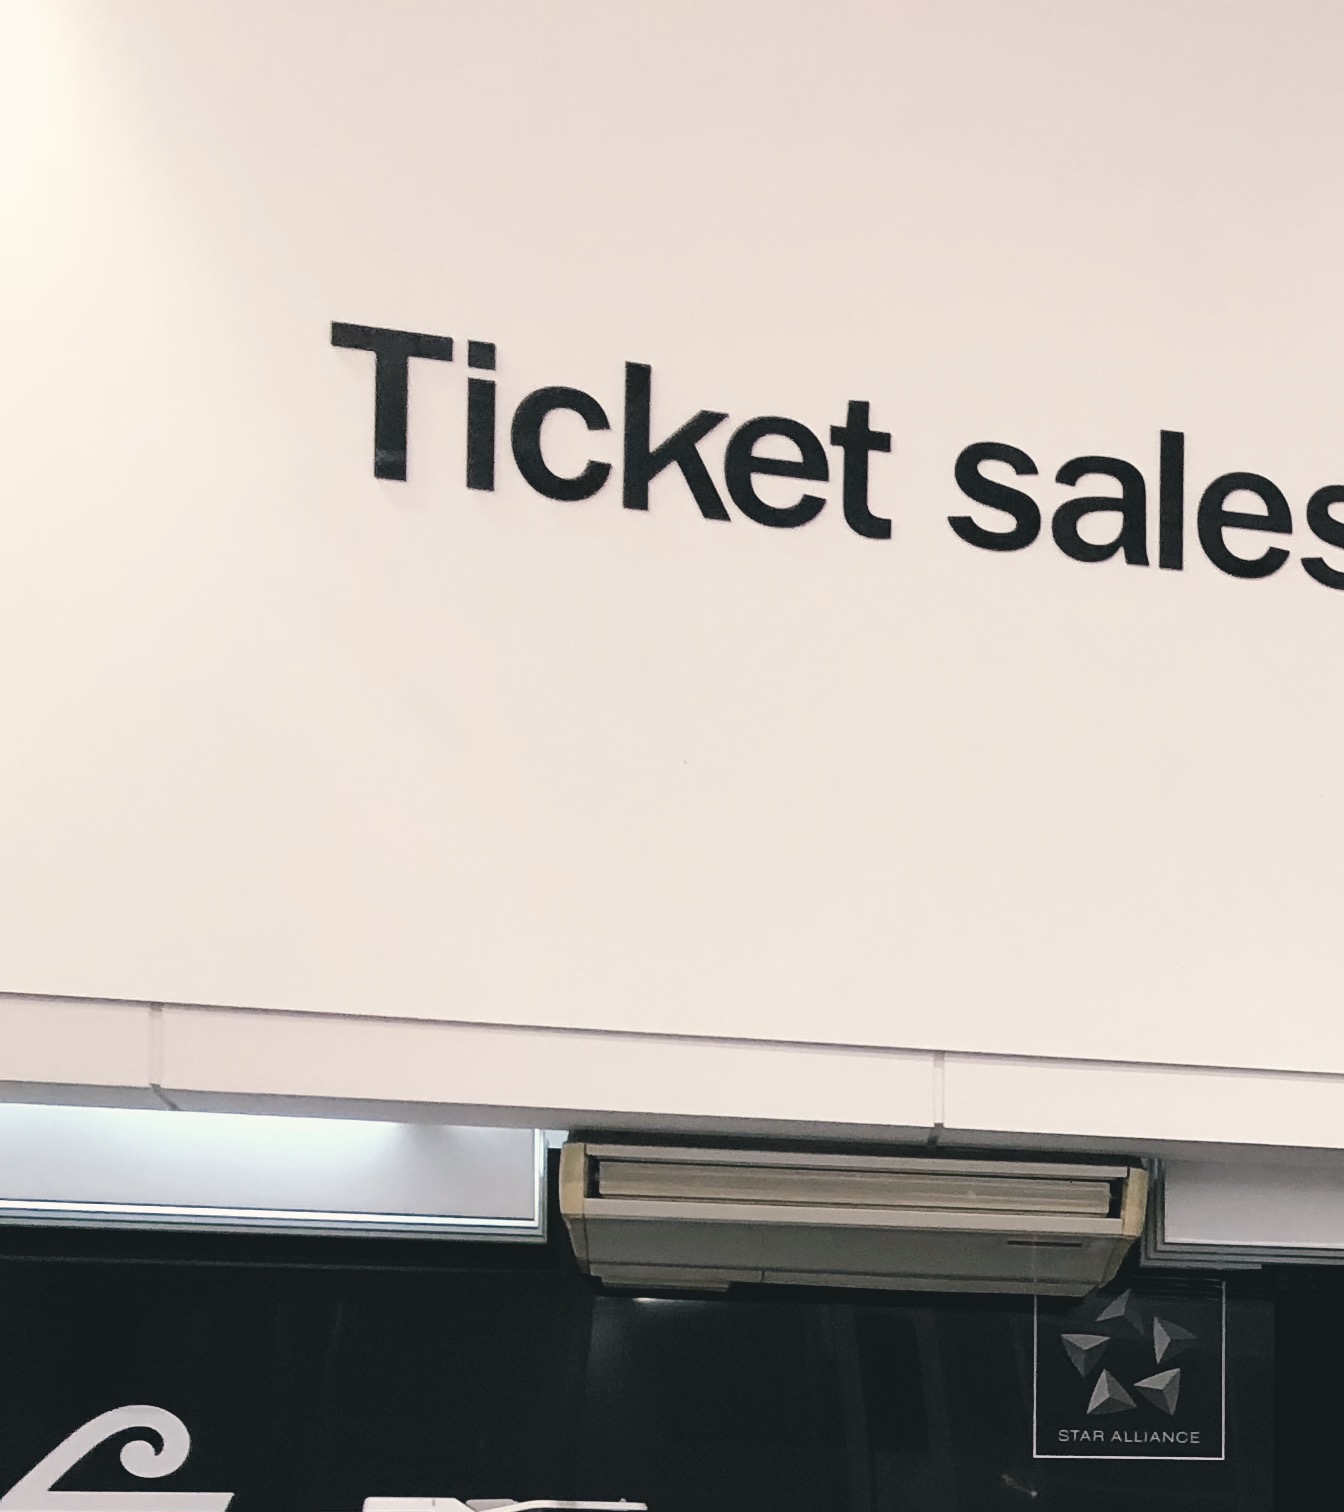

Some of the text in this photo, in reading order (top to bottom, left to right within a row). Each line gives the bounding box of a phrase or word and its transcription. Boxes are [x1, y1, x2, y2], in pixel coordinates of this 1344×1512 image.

[330, 321, 892, 540] Ticket
[1057, 1428, 1201, 1445] STAR ALLIANCE
